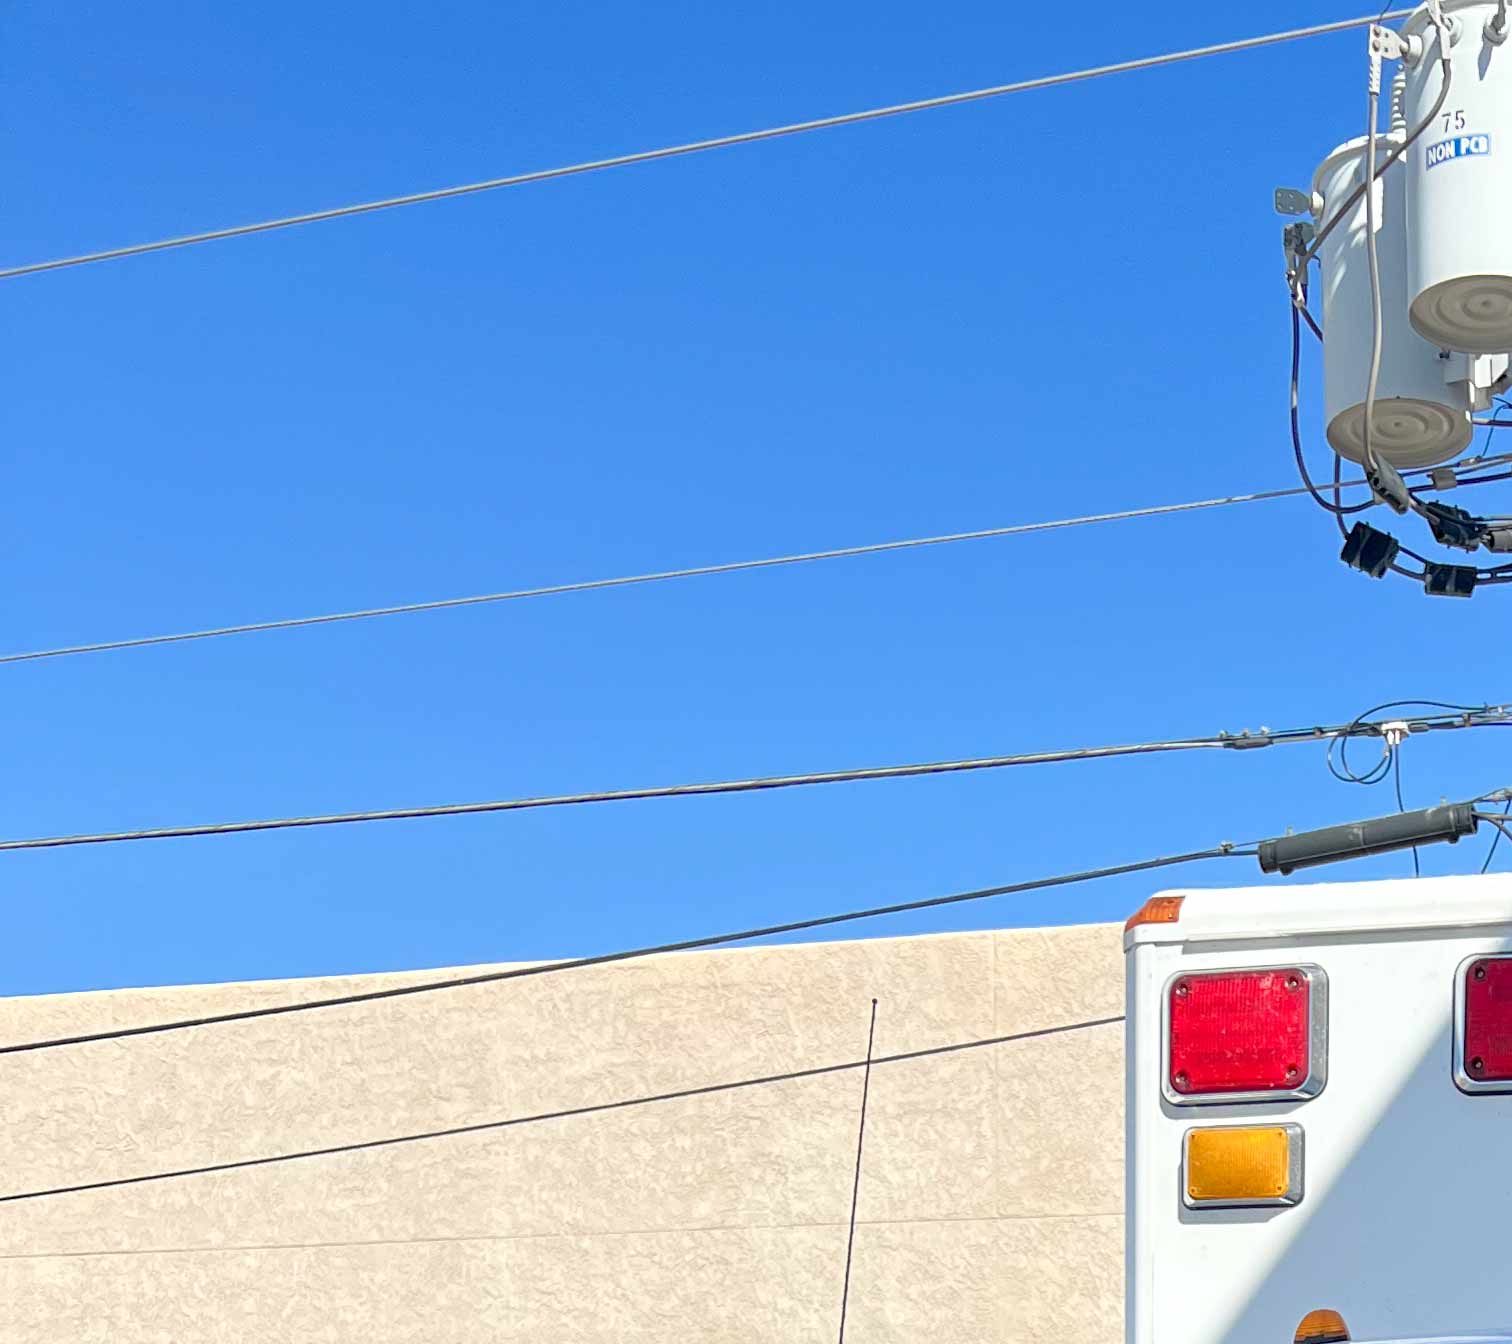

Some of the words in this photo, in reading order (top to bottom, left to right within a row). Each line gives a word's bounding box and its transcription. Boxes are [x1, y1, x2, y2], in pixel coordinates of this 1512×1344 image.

[1441, 110, 1465, 132] 75
[1427, 140, 1456, 165] NON
[1460, 136, 1488, 155] PCB
